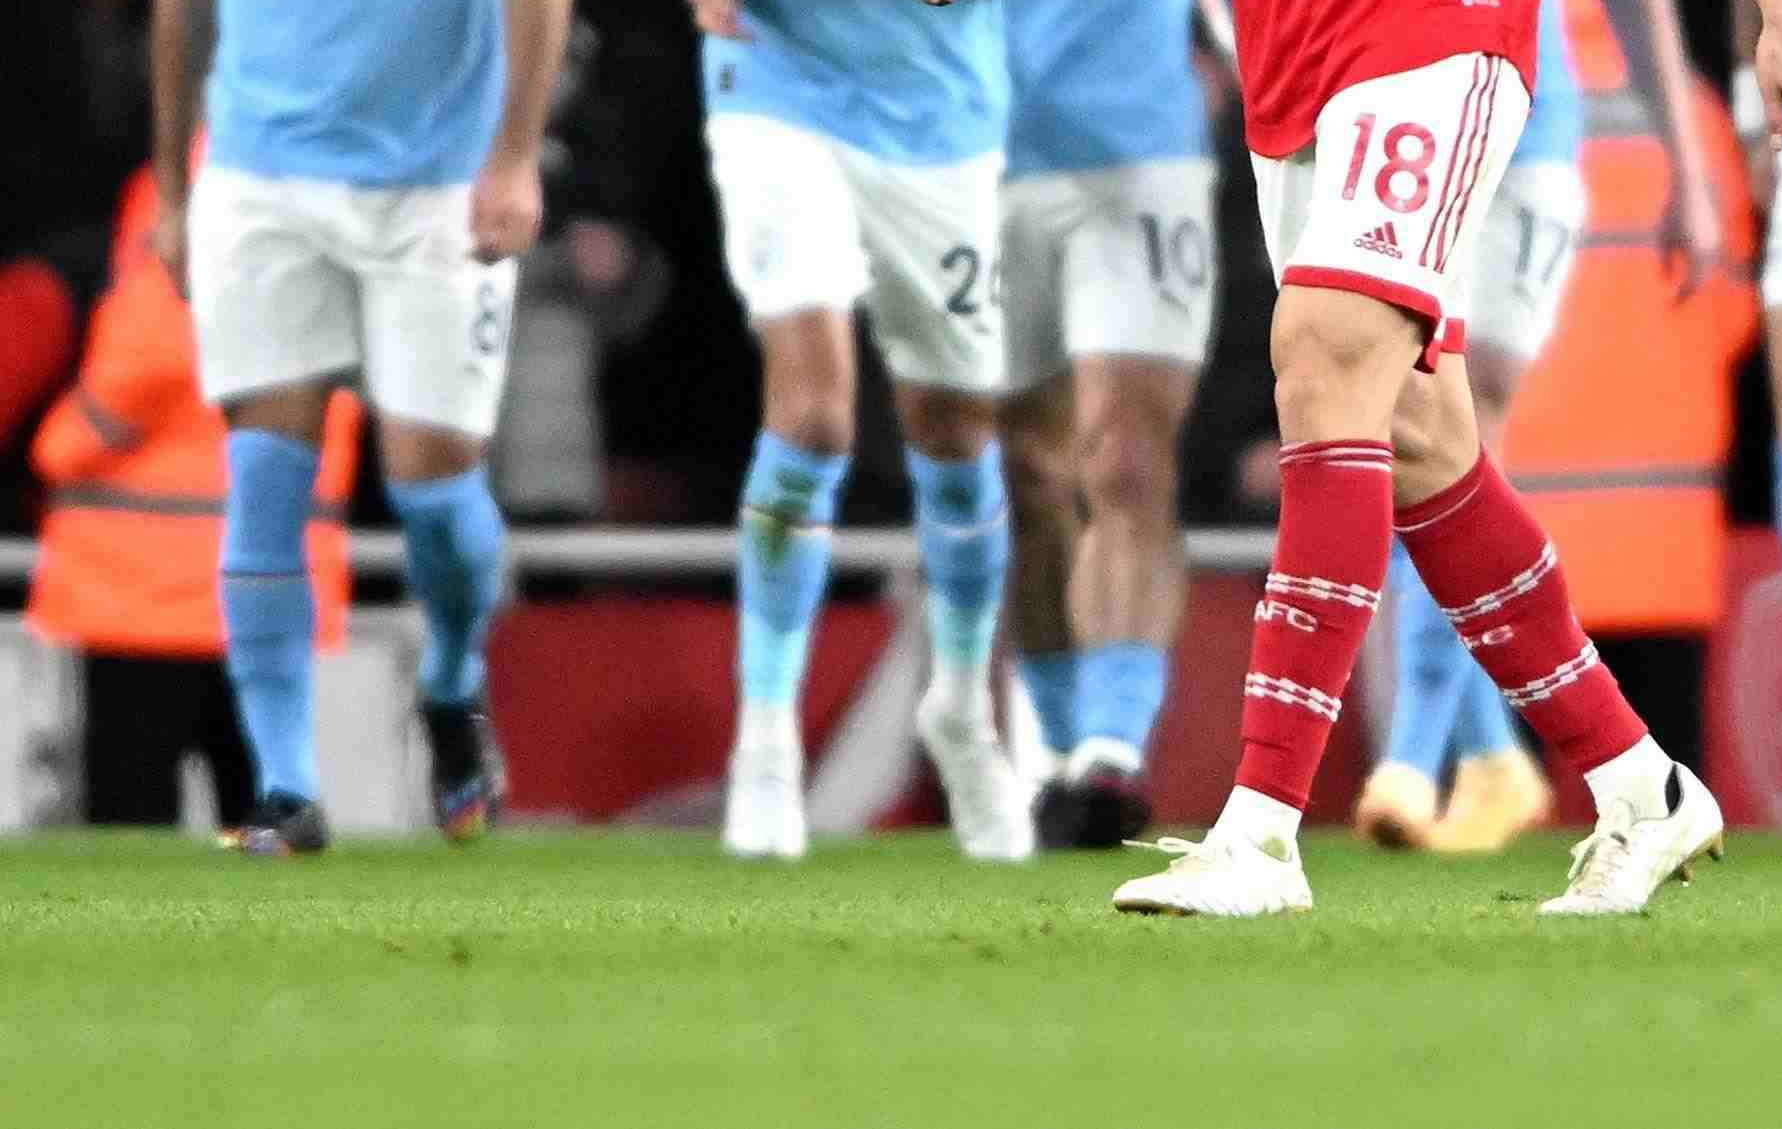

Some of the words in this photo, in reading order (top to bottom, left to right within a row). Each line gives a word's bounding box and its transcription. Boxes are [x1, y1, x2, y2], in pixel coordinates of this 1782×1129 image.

[1342, 112, 1436, 213] 18
[1137, 212, 1204, 288] 10
[1353, 238, 1403, 260] adidas
[1515, 205, 1569, 280] 17
[1253, 599, 1318, 632] AFC
